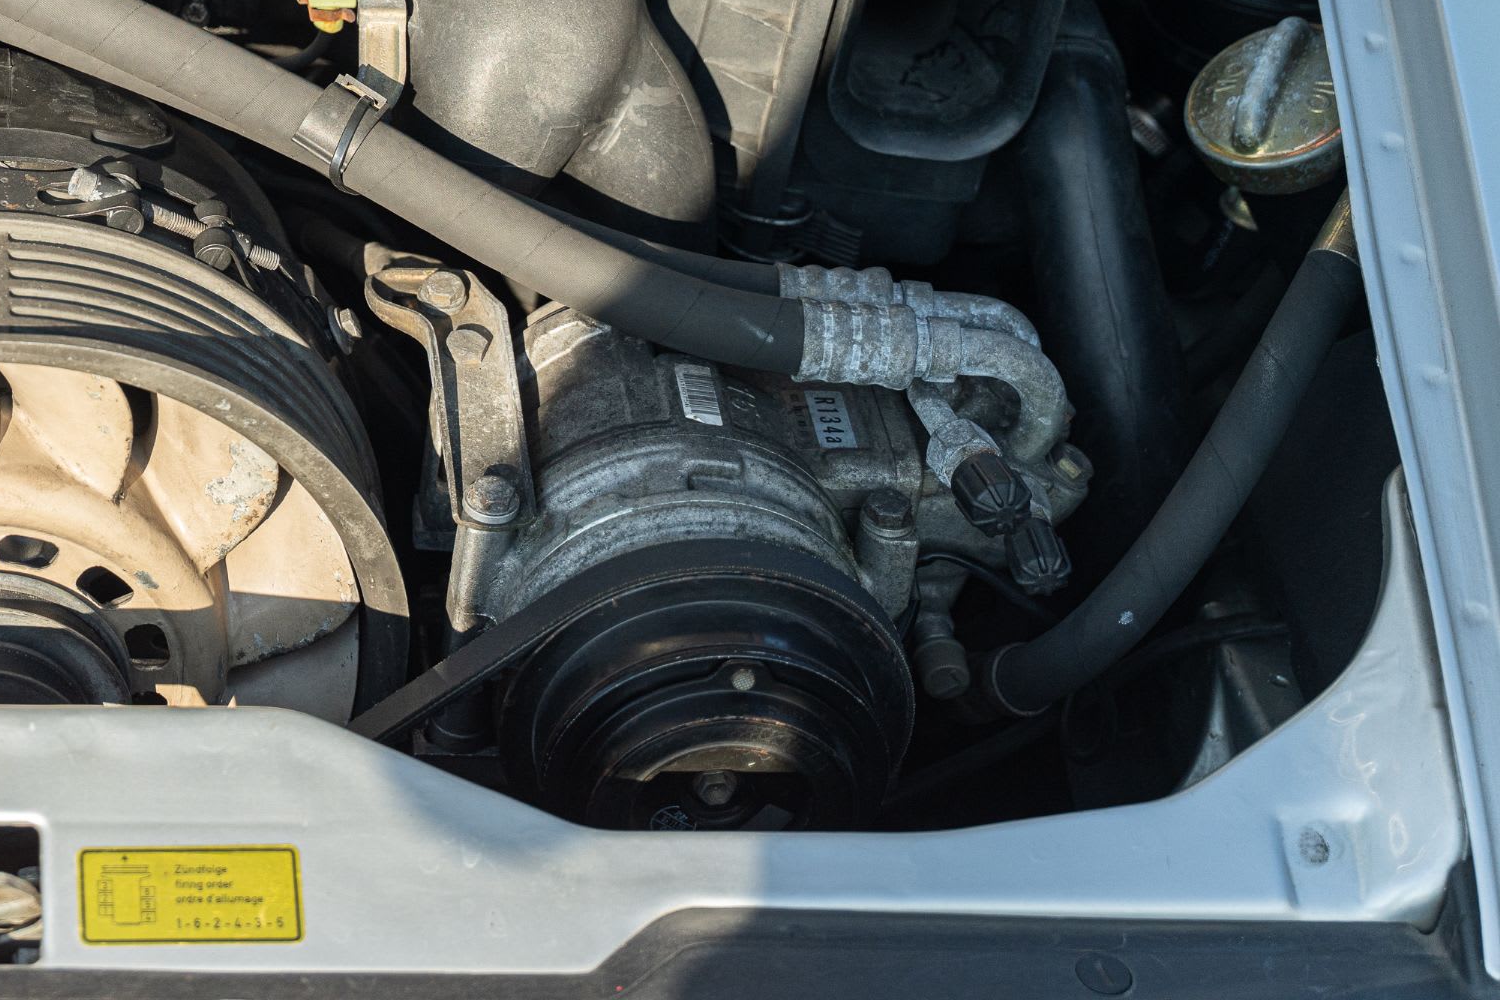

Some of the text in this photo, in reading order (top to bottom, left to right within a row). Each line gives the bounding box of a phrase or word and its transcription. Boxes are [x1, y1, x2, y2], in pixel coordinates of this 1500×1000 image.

[814, 397, 844, 444] R134a
[205, 880, 231, 888] order
[175, 895, 203, 903] ordre
